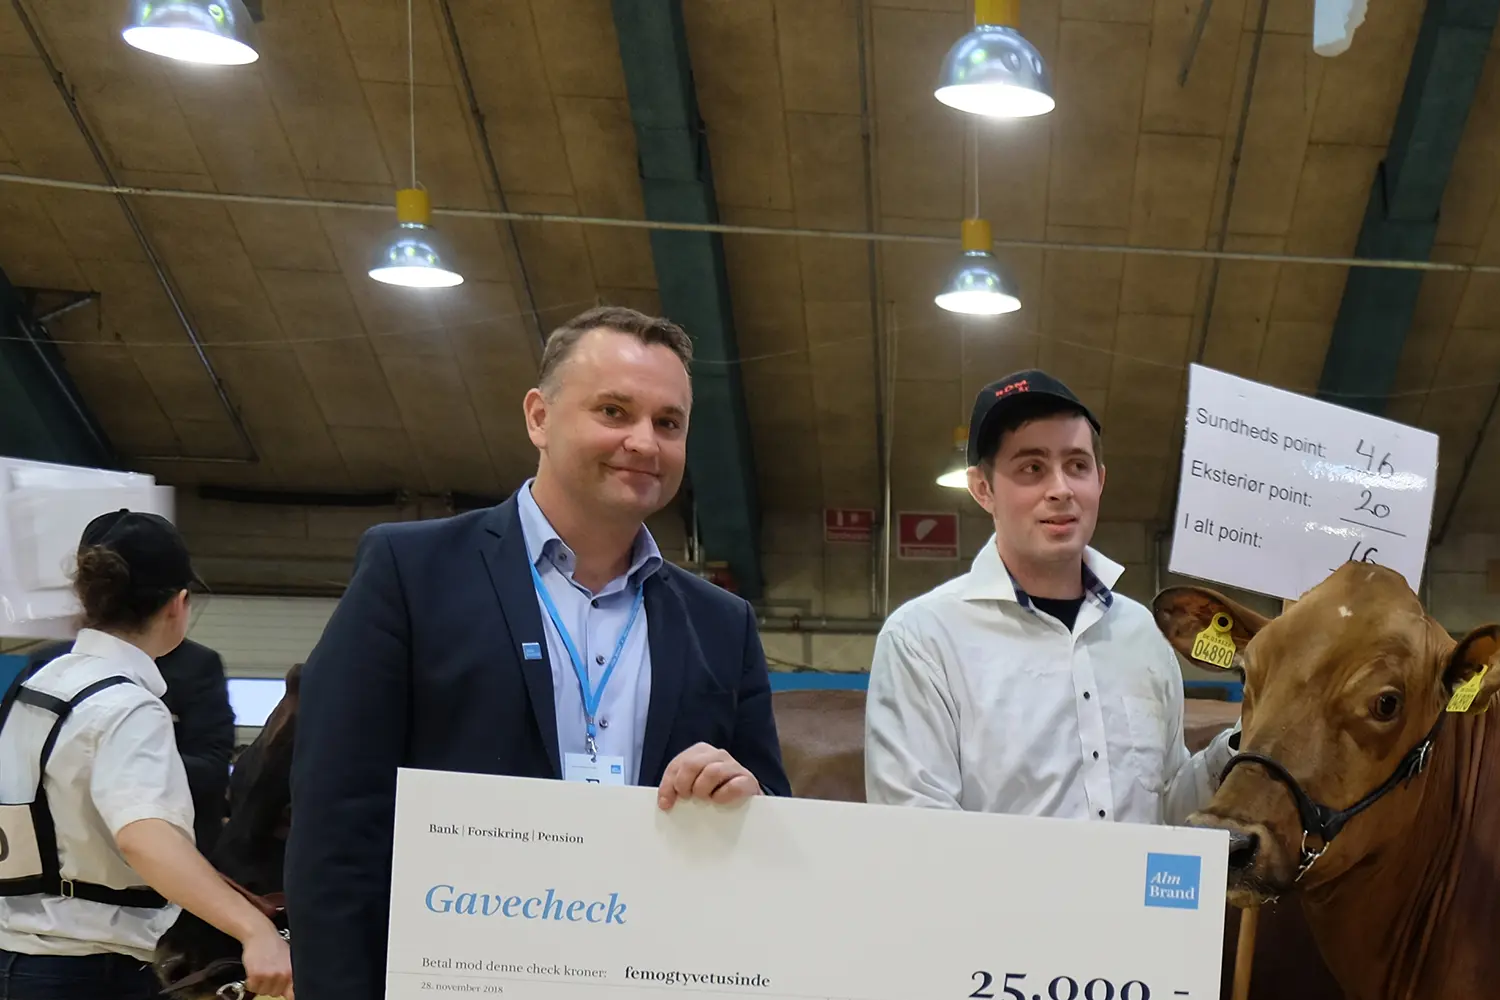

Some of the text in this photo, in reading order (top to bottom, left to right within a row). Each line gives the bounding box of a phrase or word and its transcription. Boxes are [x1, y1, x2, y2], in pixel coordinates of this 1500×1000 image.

[1196, 407, 1327, 458] Sundheds point:
[1355, 439, 1394, 479] 46
[1191, 459, 1313, 508] Eksteriør point:
[1354, 490, 1391, 518] 20
[1184, 513, 1263, 549] I alt point:
[1194, 639, 1233, 667] 04890
[428, 823, 585, 844] Bank Forsikring Pension
[1151, 871, 1181, 885] Alm
[425, 884, 627, 925] Gavecheck
[1149, 885, 1195, 900] Brand
[422, 957, 608, 979] Betal mod denne check kroner:
[625, 965, 771, 987] femogtyvetusinde
[420, 981, 504, 994] 28. november 2018
